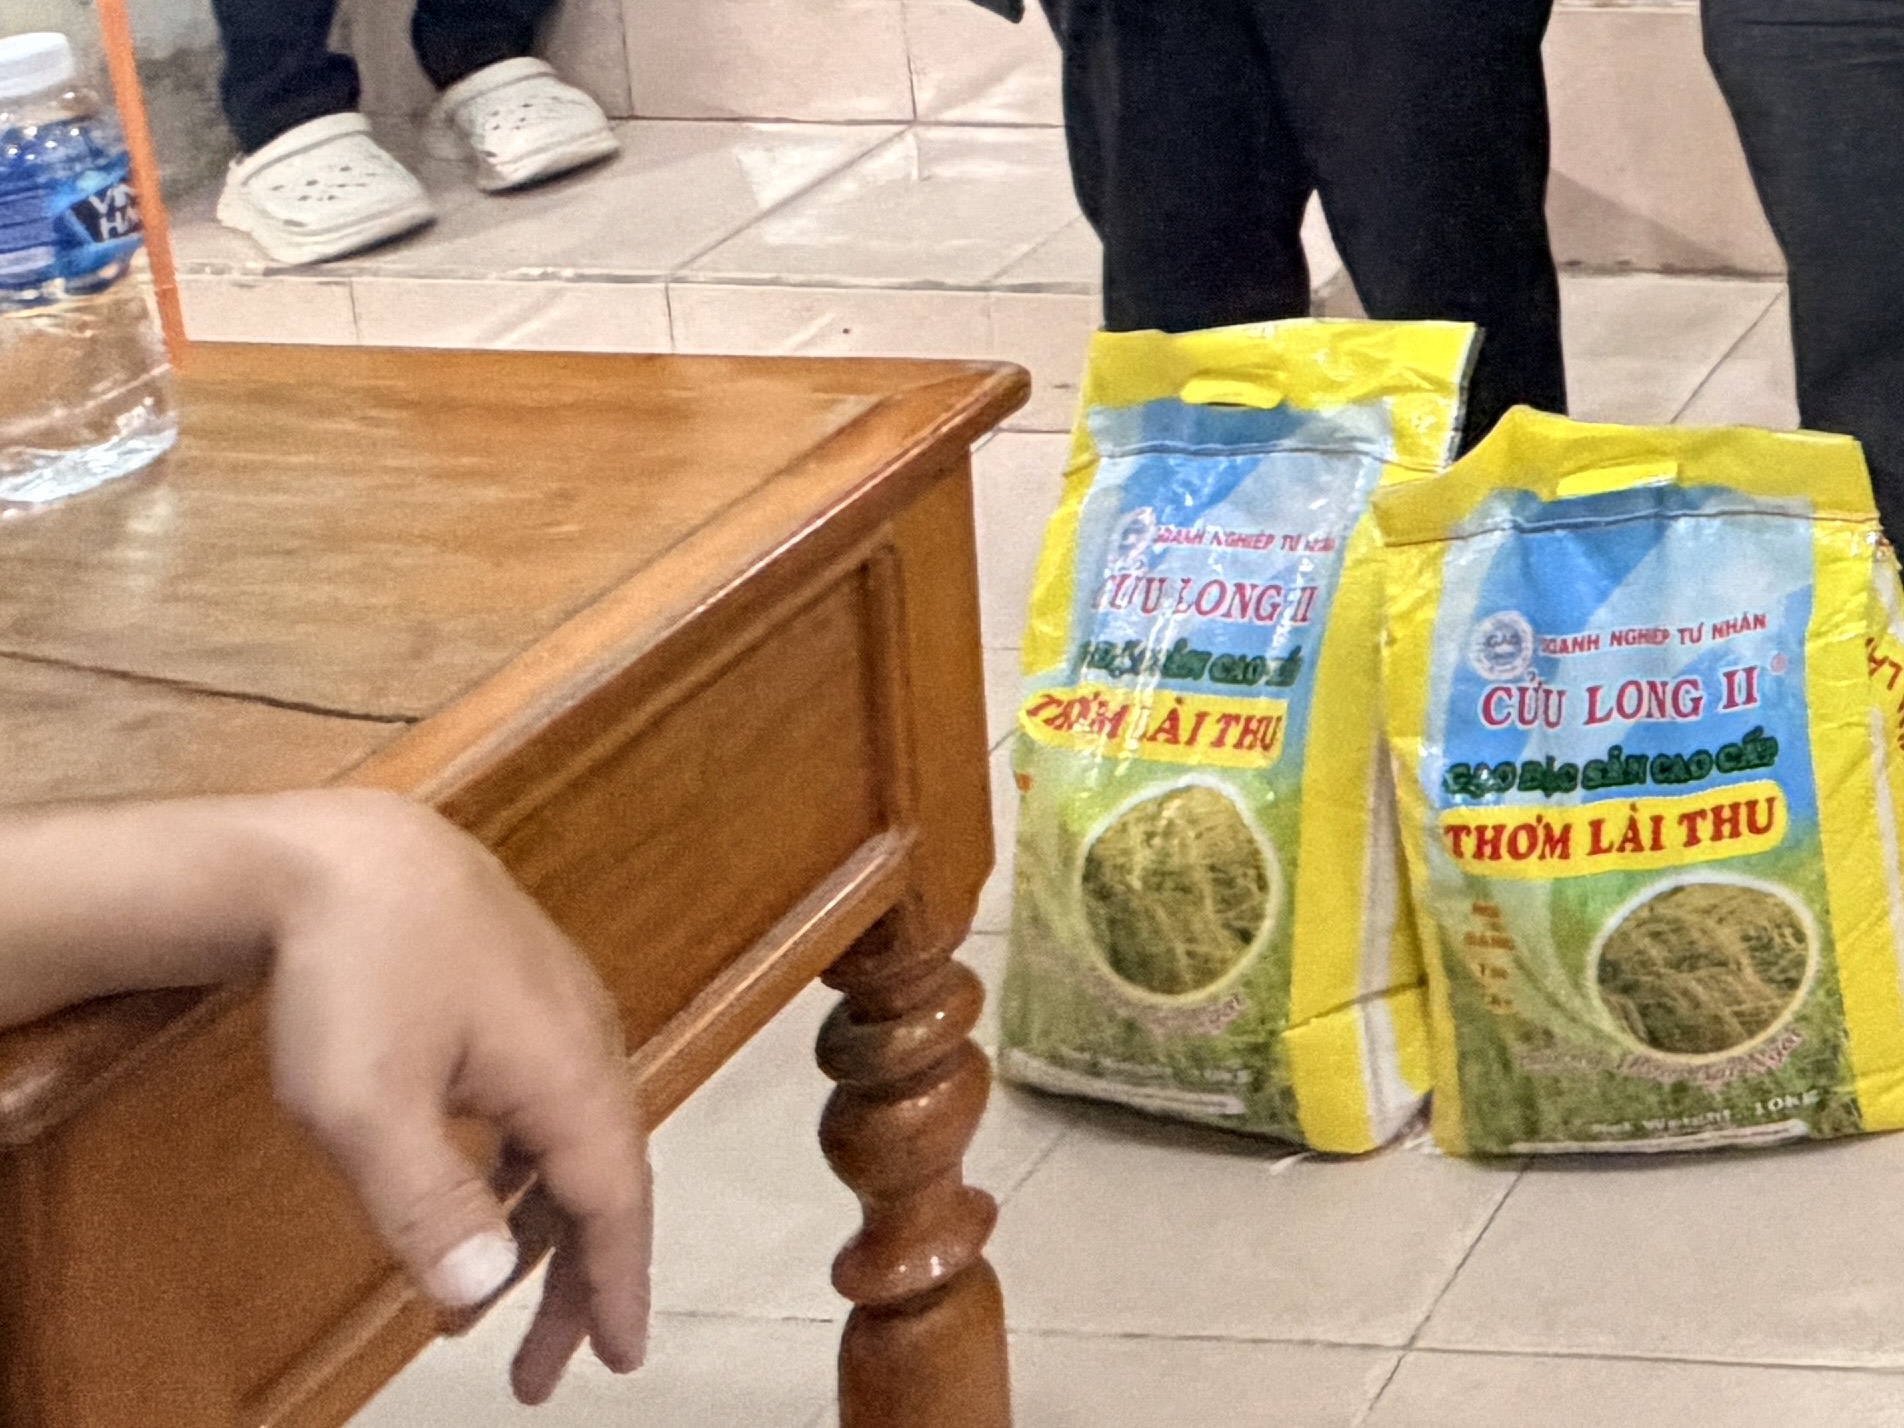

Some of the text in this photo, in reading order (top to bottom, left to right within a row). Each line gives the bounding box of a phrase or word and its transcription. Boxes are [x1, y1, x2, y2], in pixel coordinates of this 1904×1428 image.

[1584, 678, 1704, 726] LONG
[1722, 665, 1758, 711] II
[1444, 814, 1573, 862] THƠM
[1678, 796, 1778, 848] THU
